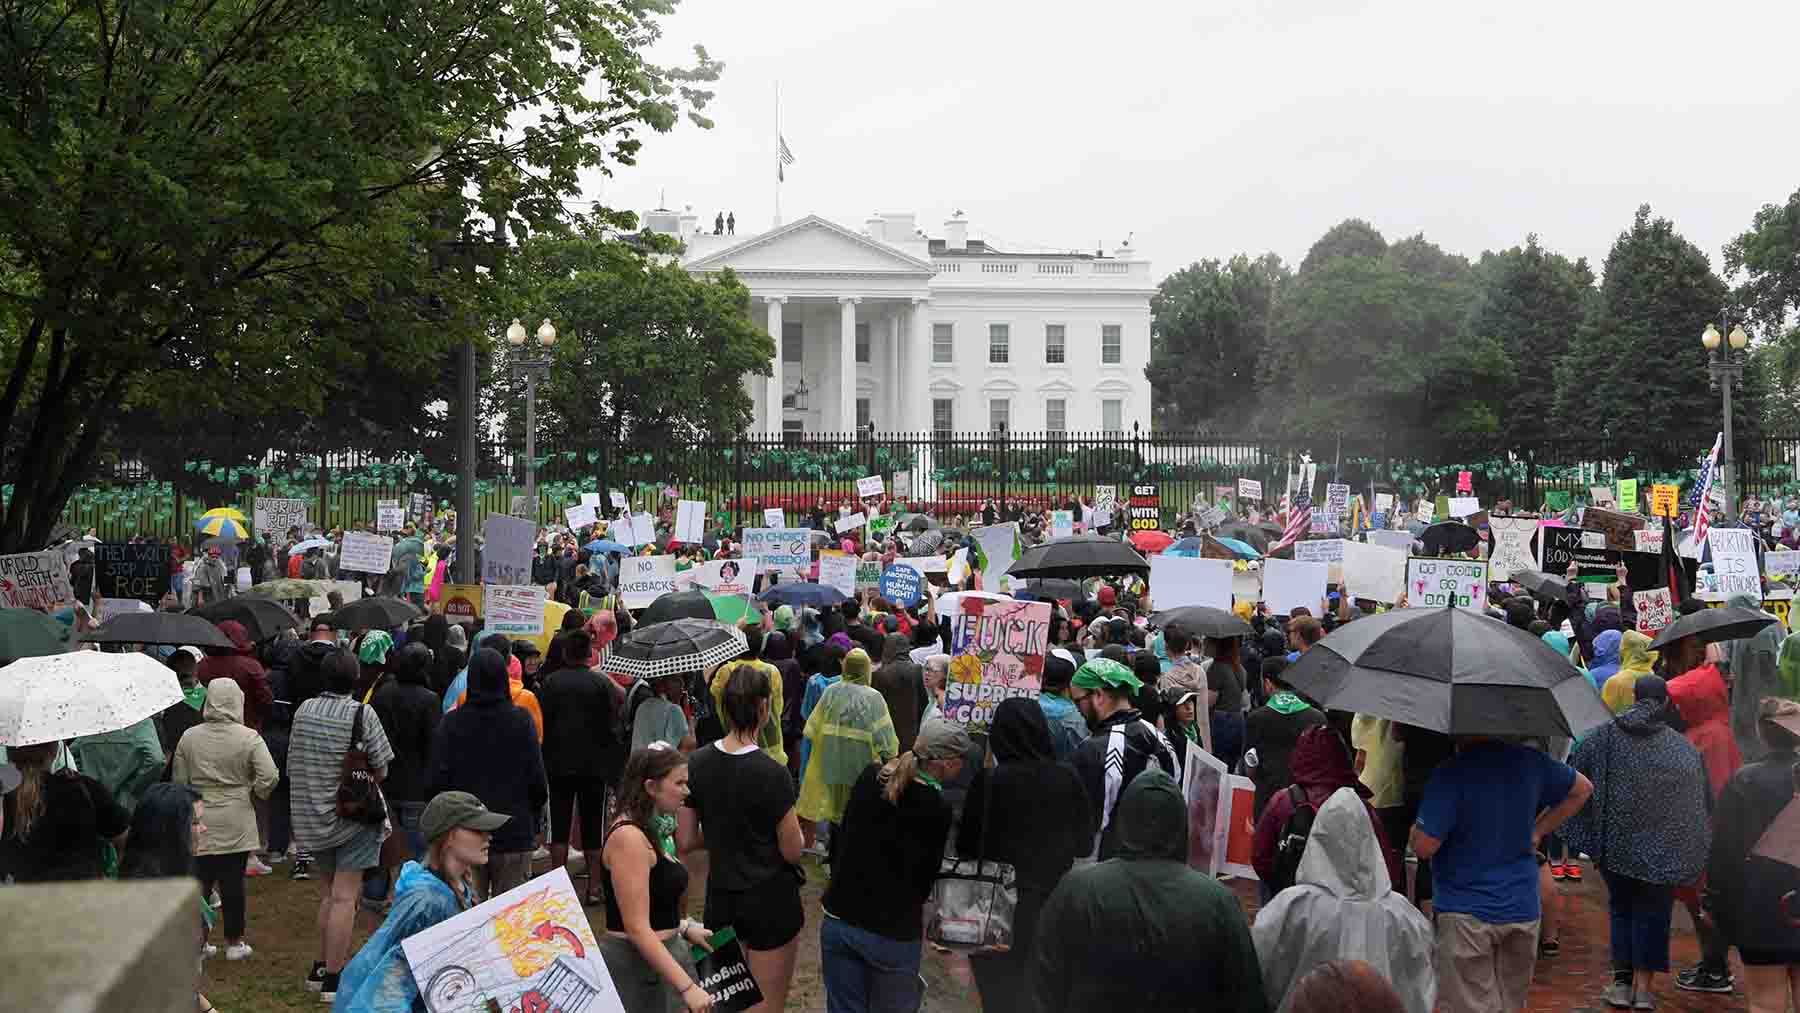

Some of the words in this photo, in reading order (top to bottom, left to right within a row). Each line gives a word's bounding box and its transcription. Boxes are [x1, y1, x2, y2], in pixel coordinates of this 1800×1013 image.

[1134, 485, 1155, 496] GET
[1131, 507, 1159, 518] WITH
[1131, 518, 1159, 530] GOD
[746, 532, 764, 542] NO
[766, 531, 807, 542] CHOICE
[1555, 532, 1582, 550] MY
[96, 544, 128, 561] THEY
[104, 560, 136, 577] STOP
[143, 560, 161, 577] AT
[637, 561, 653, 572] NO
[895, 565, 912, 575] SAFE
[1721, 558, 1745, 574] IS
[17, 570, 53, 588] BIRTH
[885, 571, 919, 581] ABORTION
[115, 575, 159, 597] ROE
[886, 580, 917, 593] HUMAN
[1440, 579, 1457, 590] GO
[1425, 593, 1470, 607] BAK
[957, 614, 1049, 656] FUCK
[948, 681, 1041, 703] SUPREME
[956, 703, 995, 724] COU
